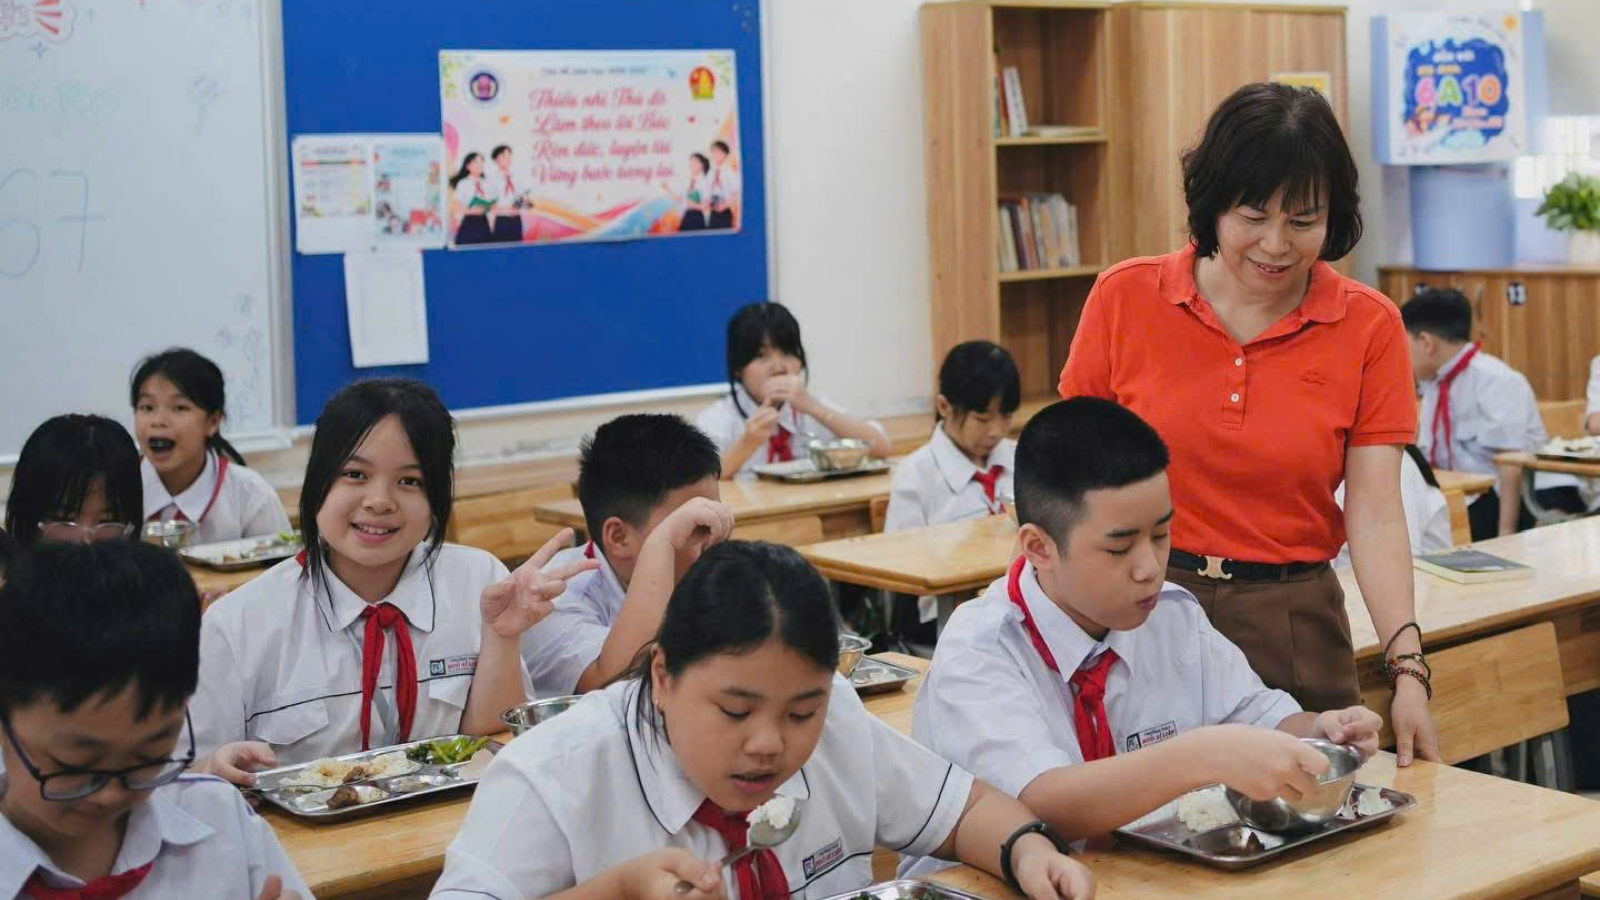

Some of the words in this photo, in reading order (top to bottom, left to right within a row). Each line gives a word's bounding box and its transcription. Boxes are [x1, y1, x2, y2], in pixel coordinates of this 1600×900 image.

[582, 91, 607, 107] nhi
[1415, 74, 1501, 107] 6A10
[533, 112, 577, 135] Làm
[581, 114, 611, 130] theo
